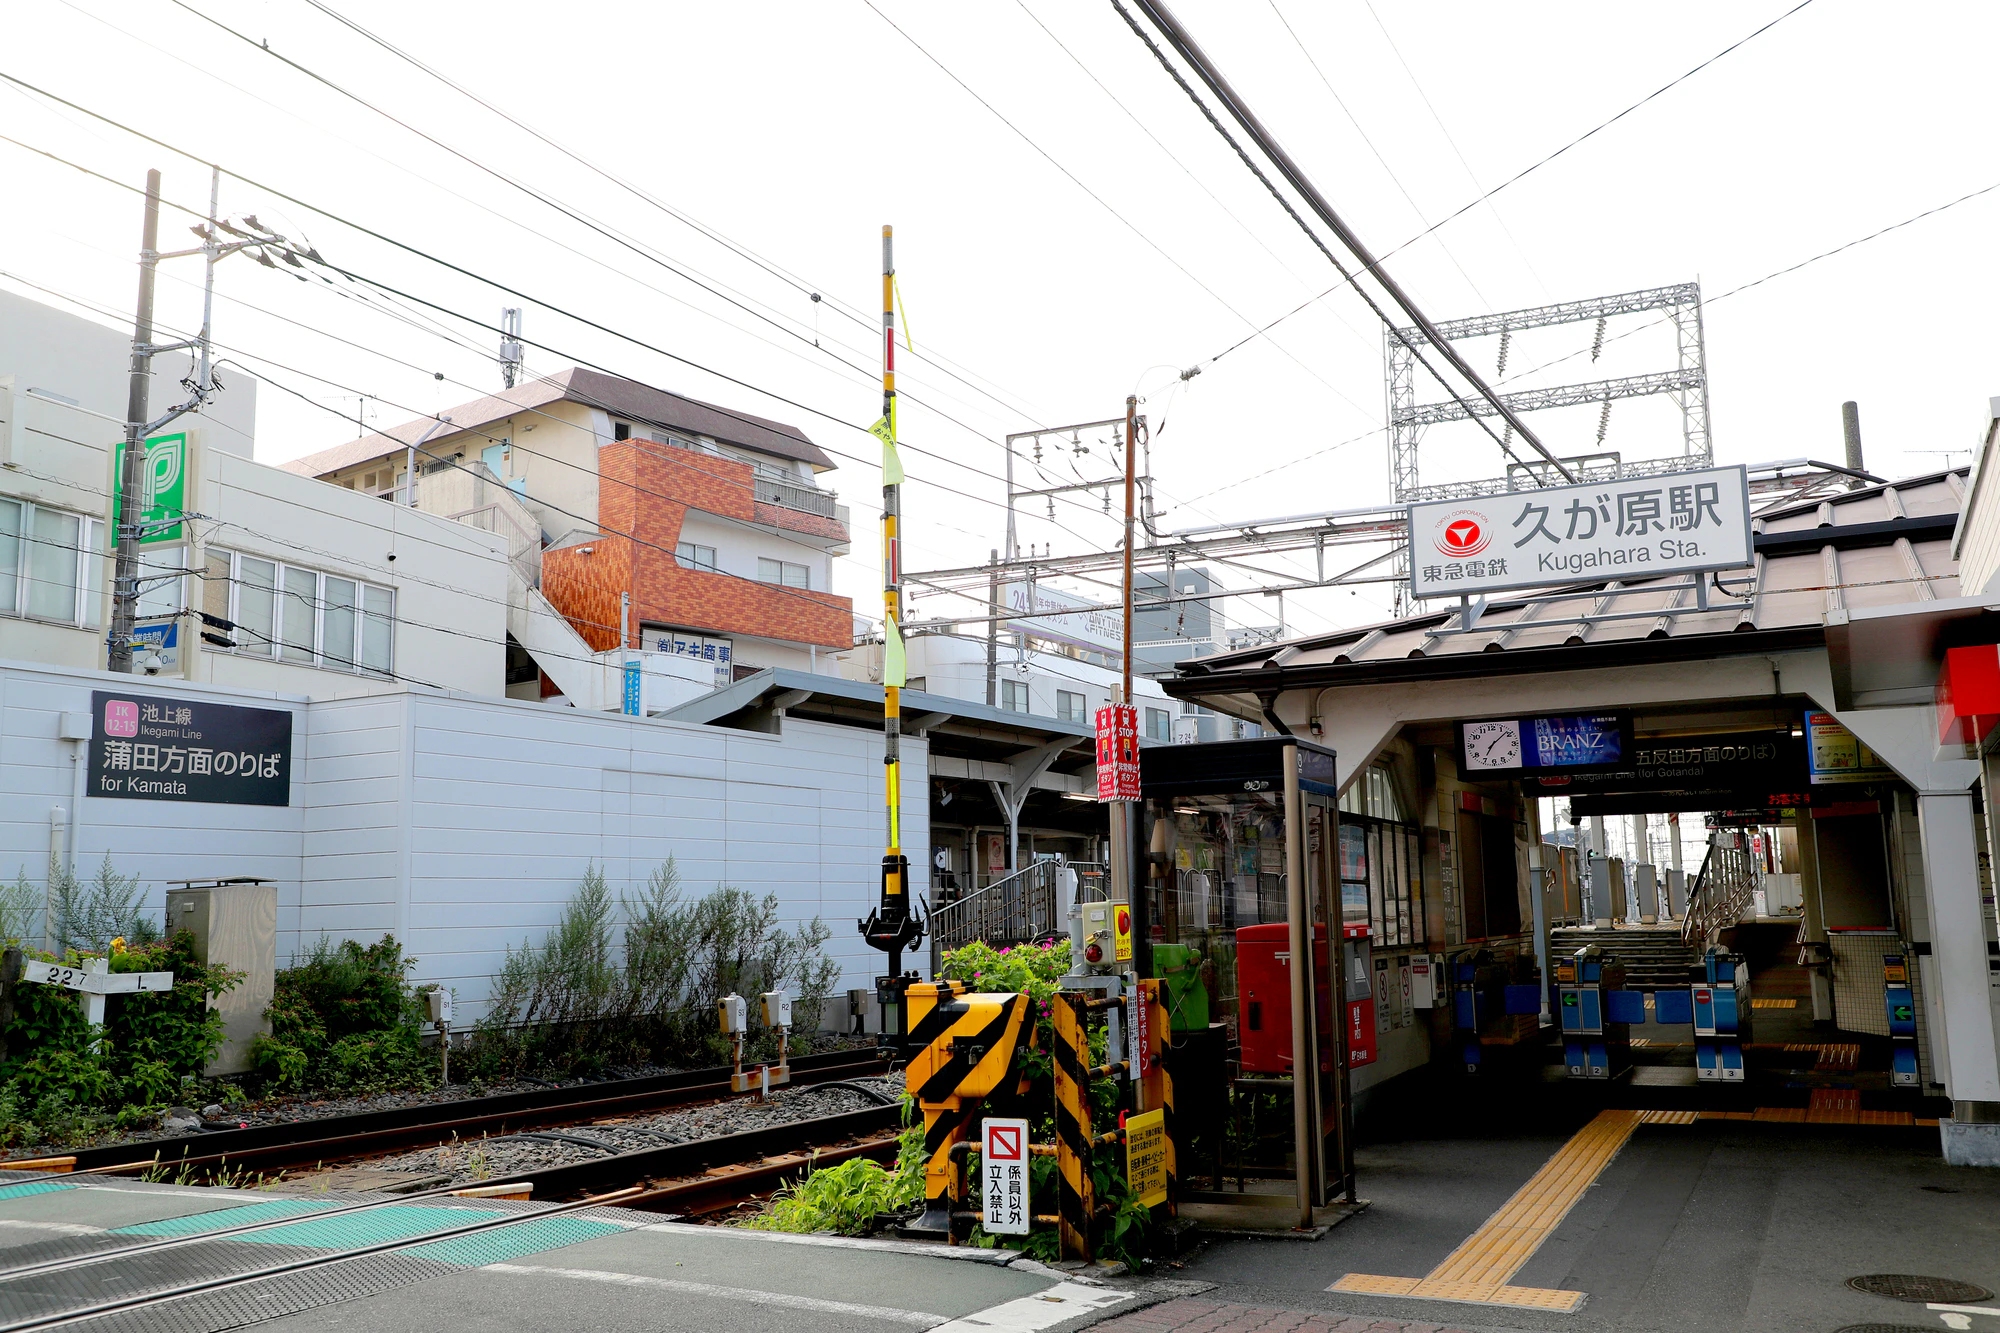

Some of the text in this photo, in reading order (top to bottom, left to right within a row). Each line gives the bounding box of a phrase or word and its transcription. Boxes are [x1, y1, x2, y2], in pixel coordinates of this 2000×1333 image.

[1435, 510, 1489, 528] TOKYU CORPORATION
[1512, 482, 1723, 548] 久が原駅
[1538, 540, 1706, 574] Kugahara Sta.
[1422, 558, 1508, 582] 東急電鉄
[1089, 612, 1124, 631] ANYTIM
[134, 631, 162, 643] 業時間
[1089, 624, 1124, 642] FITNES
[116, 706, 128, 717] IK
[141, 704, 192, 726] 池上線
[107, 720, 136, 732] 12-15
[141, 725, 202, 740] Ikegami Line
[1099, 728, 1110, 739] STOP
[1119, 728, 1134, 737] STOP
[1539, 732, 1604, 750] BRANZ
[102, 740, 281, 778] 蒲田方面のりば
[1121, 773, 1136, 782] ボタン
[1658, 766, 1704, 776] Gotanda)
[101, 775, 187, 794] for Kamata
[1708, 816, 1714, 826] 2
[47, 968, 147, 989] 22.7 L
[989, 1165, 1002, 1224] 立入禁止
[1008, 1165, 1022, 1225] 係員以外
